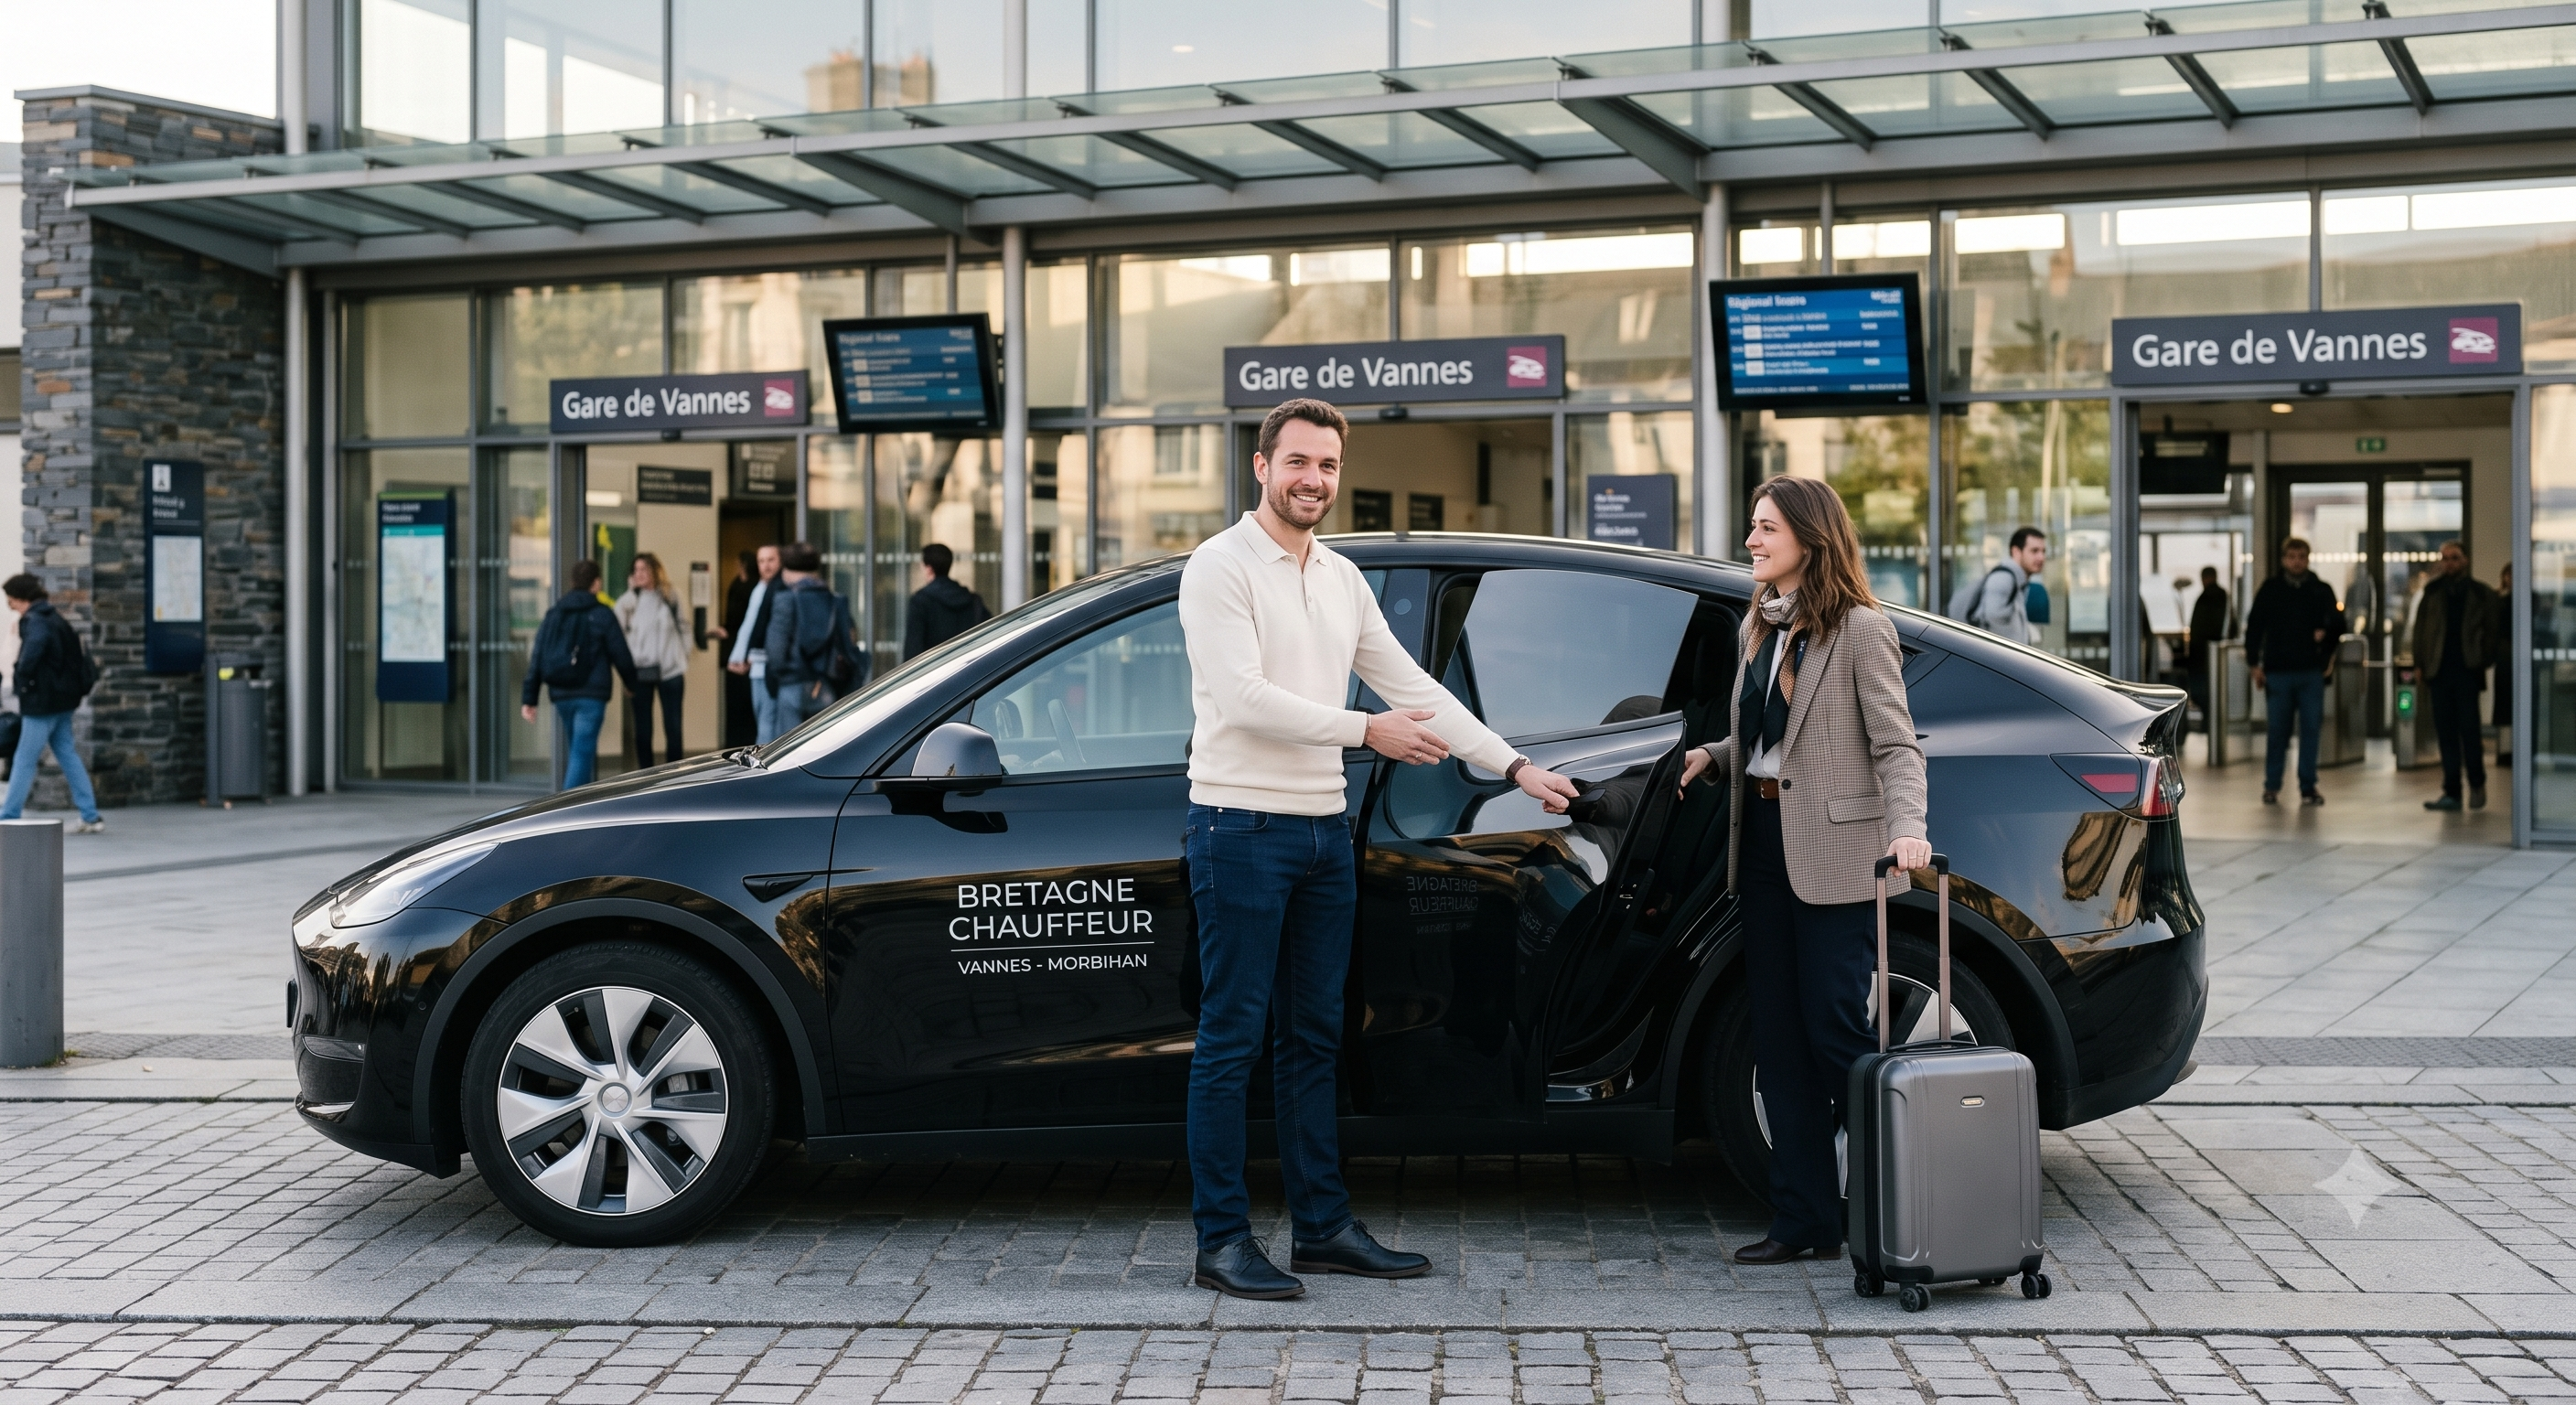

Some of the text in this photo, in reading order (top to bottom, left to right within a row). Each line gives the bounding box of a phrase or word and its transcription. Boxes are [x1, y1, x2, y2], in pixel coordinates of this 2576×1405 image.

[2131, 328, 2429, 368] Gare de Vannes
[1239, 357, 1474, 391] Gare de Vannes
[562, 387, 752, 420] Gare de Vannes
[957, 877, 1135, 909] BRETAGNE
[949, 909, 1154, 941] CHAUFFEUR
[957, 958, 1032, 975] VANNES
[1047, 953, 1147, 971] MORBIHAN
